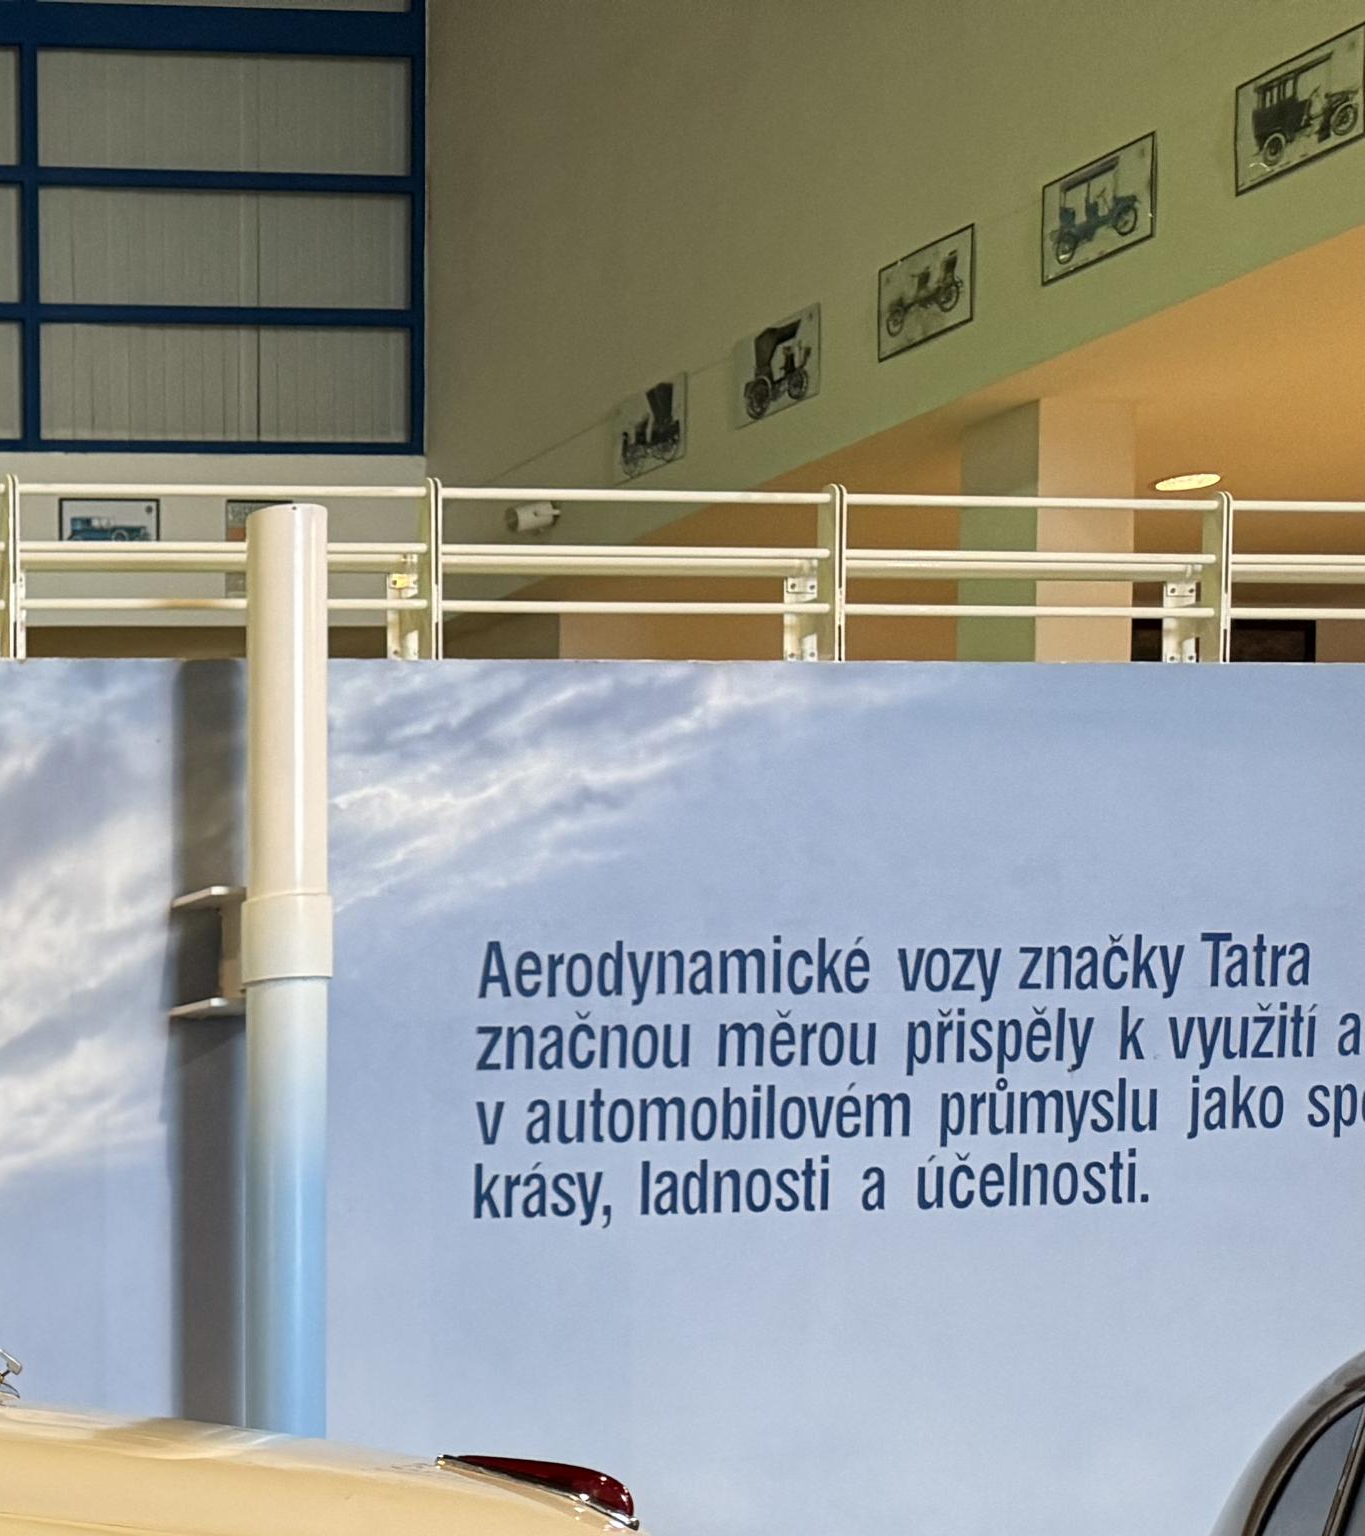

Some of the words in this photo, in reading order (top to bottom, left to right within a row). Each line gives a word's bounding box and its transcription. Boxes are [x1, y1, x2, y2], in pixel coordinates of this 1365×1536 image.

[477, 935, 870, 1006] Aerodynamické
[898, 946, 1002, 1002] vozy
[1018, 934, 1185, 999] značky
[1200, 932, 1311, 987] Tatra
[475, 1010, 691, 1070] značnou
[717, 1009, 877, 1067] měrou
[906, 1006, 1094, 1076] přispěly
[1119, 1006, 1145, 1060] k
[1169, 1002, 1318, 1070] využití
[1337, 1012, 1361, 1056] a
[475, 1101, 505, 1145] v
[525, 1082, 911, 1144] automobilovém
[940, 1077, 1158, 1147] průmyslu
[1186, 1075, 1284, 1140] jako
[1306, 1082, 1365, 1139] sp
[472, 1161, 612, 1229] krásy,
[640, 1154, 830, 1216] ladnosti
[860, 1165, 886, 1212] a
[916, 1148, 1150, 1211] účelnosti.
